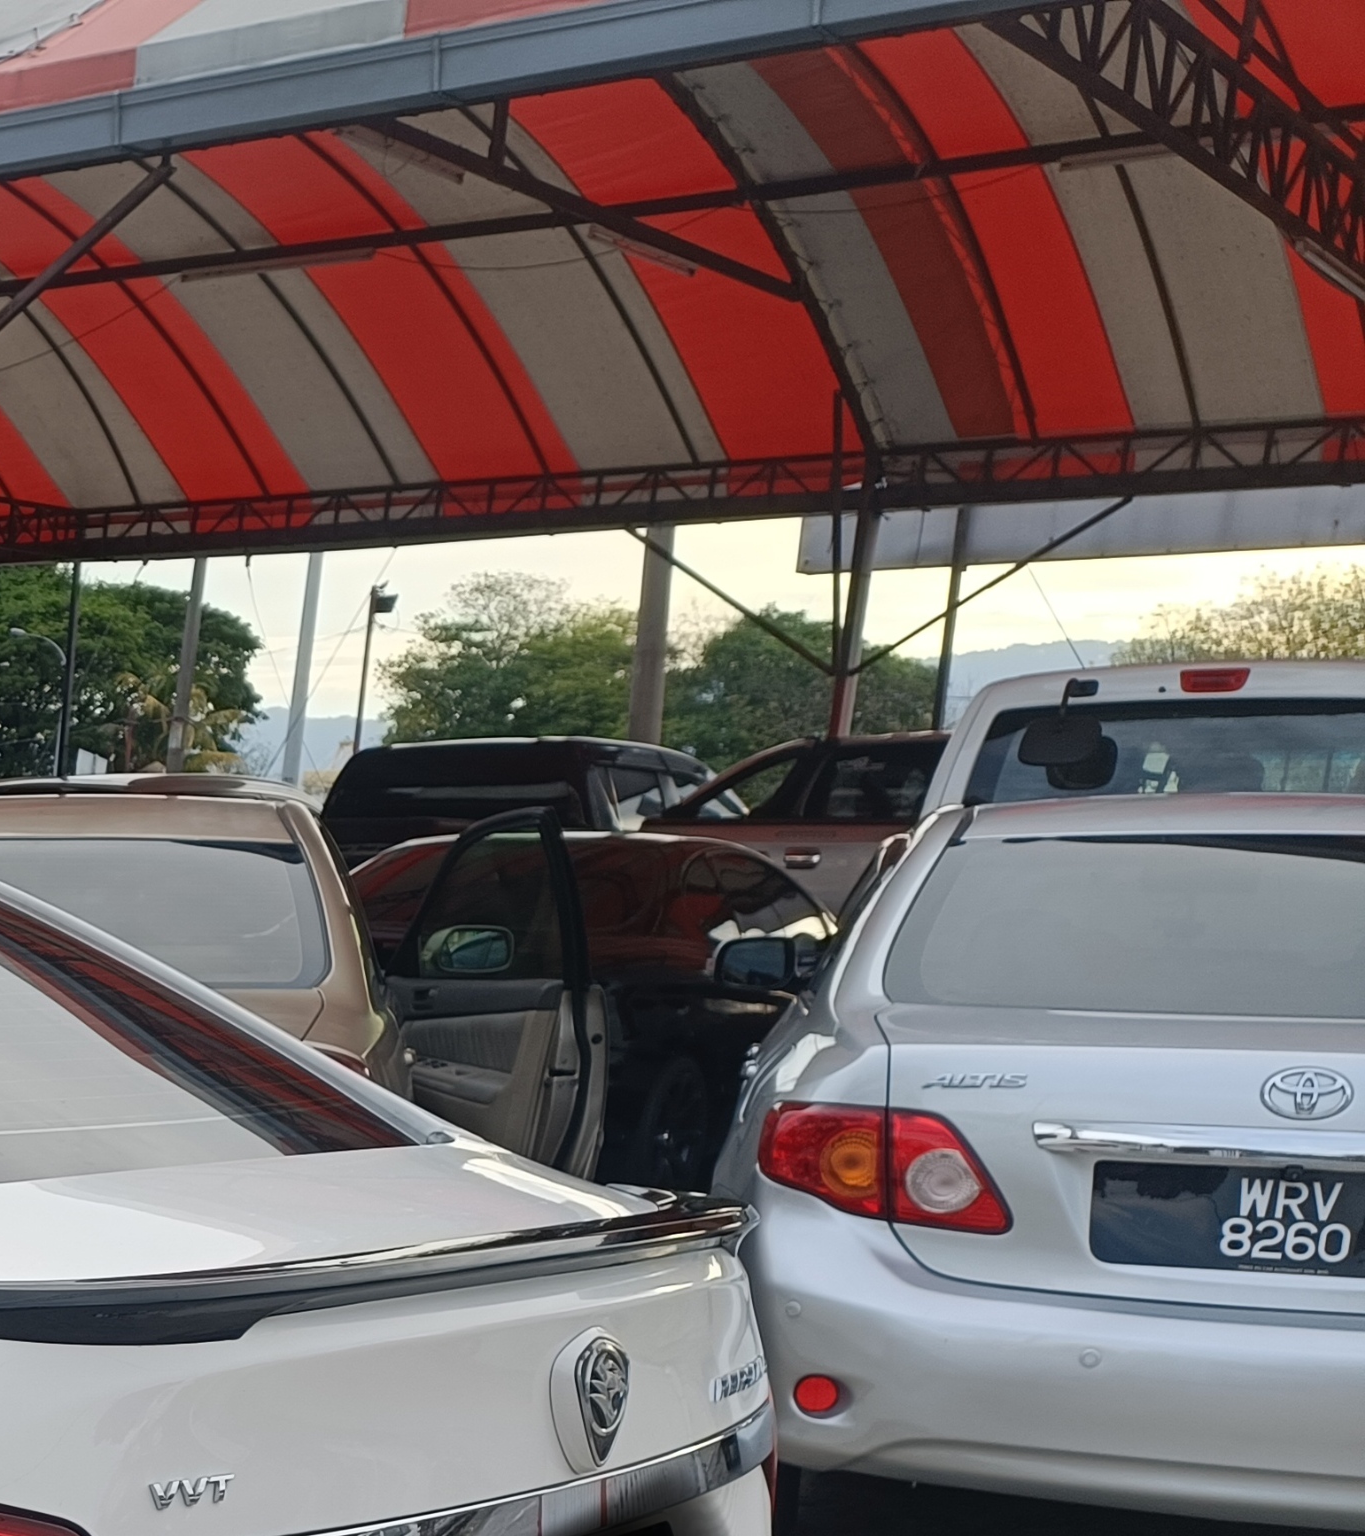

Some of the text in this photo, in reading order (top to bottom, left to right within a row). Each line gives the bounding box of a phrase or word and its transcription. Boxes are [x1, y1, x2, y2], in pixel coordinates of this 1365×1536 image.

[921, 1073, 1028, 1089] ALTIS
[1239, 1177, 1344, 1221] WRV
[1220, 1217, 1351, 1263] 8260
[149, 1473, 235, 1510] VVT
